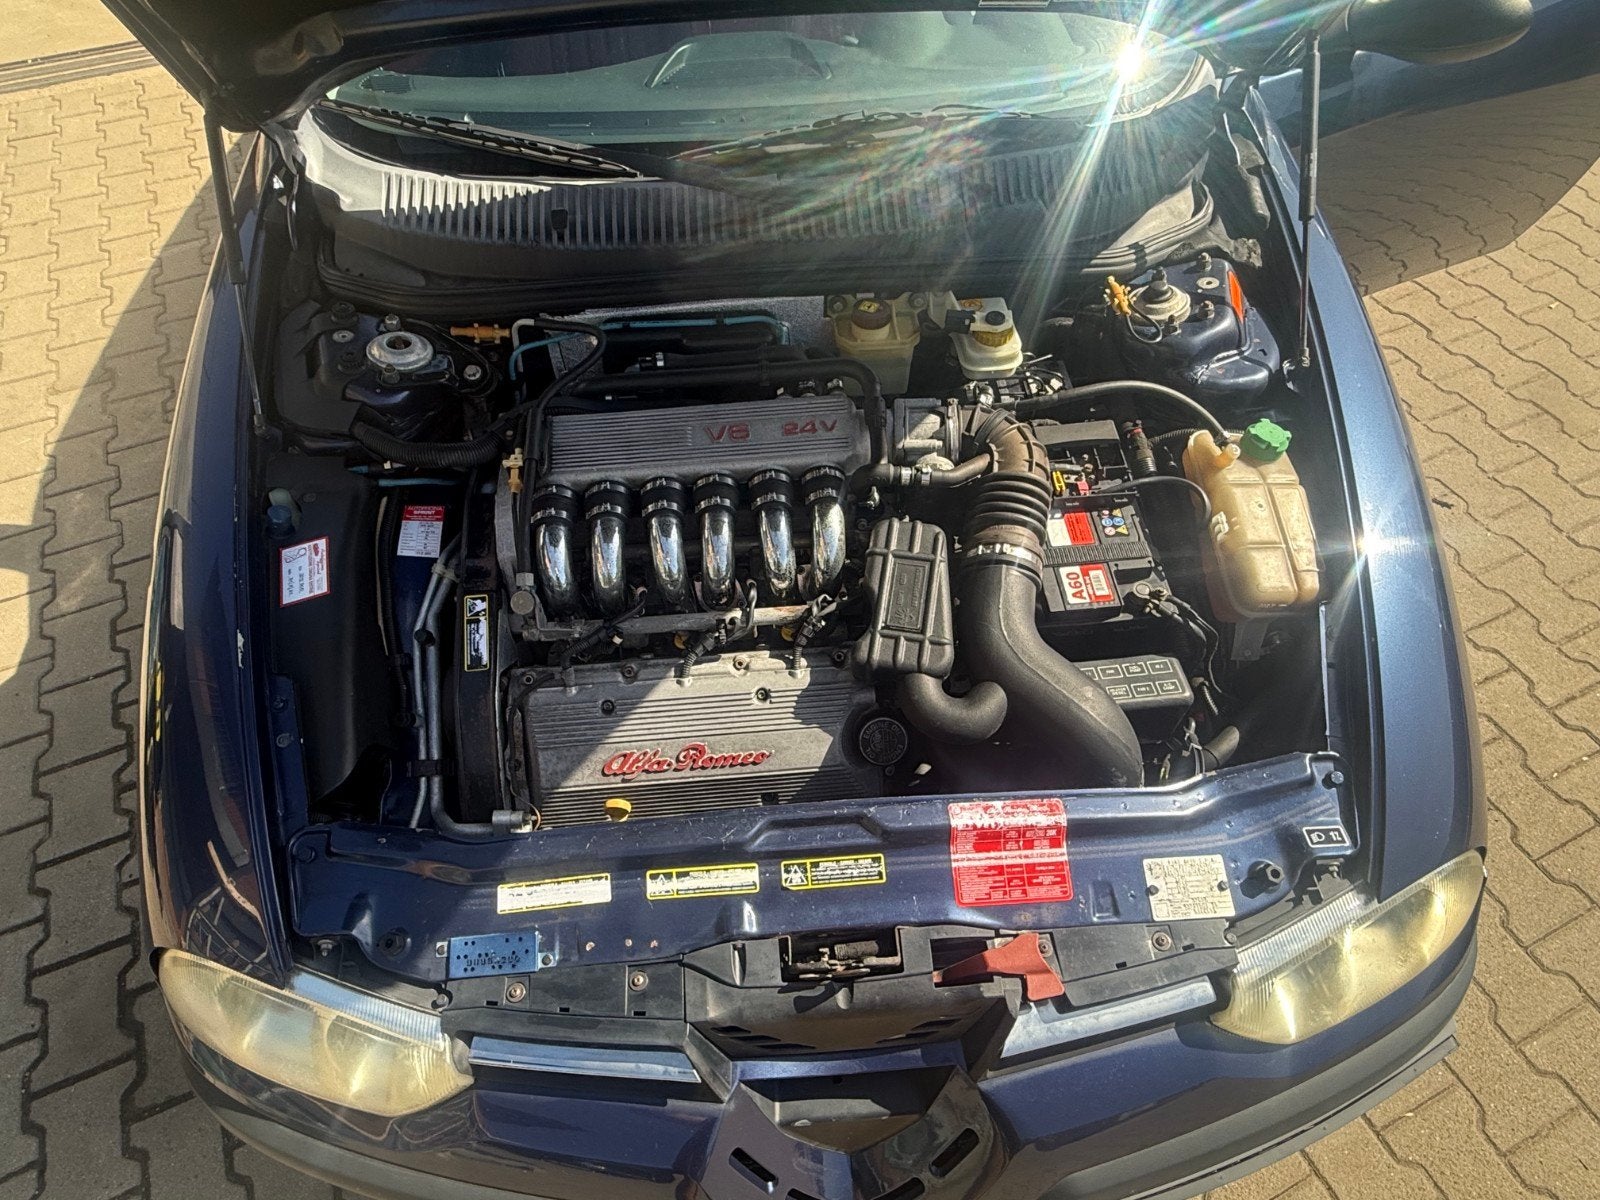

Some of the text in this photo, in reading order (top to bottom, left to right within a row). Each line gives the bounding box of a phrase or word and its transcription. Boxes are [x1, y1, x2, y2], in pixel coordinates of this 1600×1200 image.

[705, 419, 837, 442] V6 24V
[1066, 572, 1086, 600] A60
[601, 741, 776, 783] Alfa Romeo
